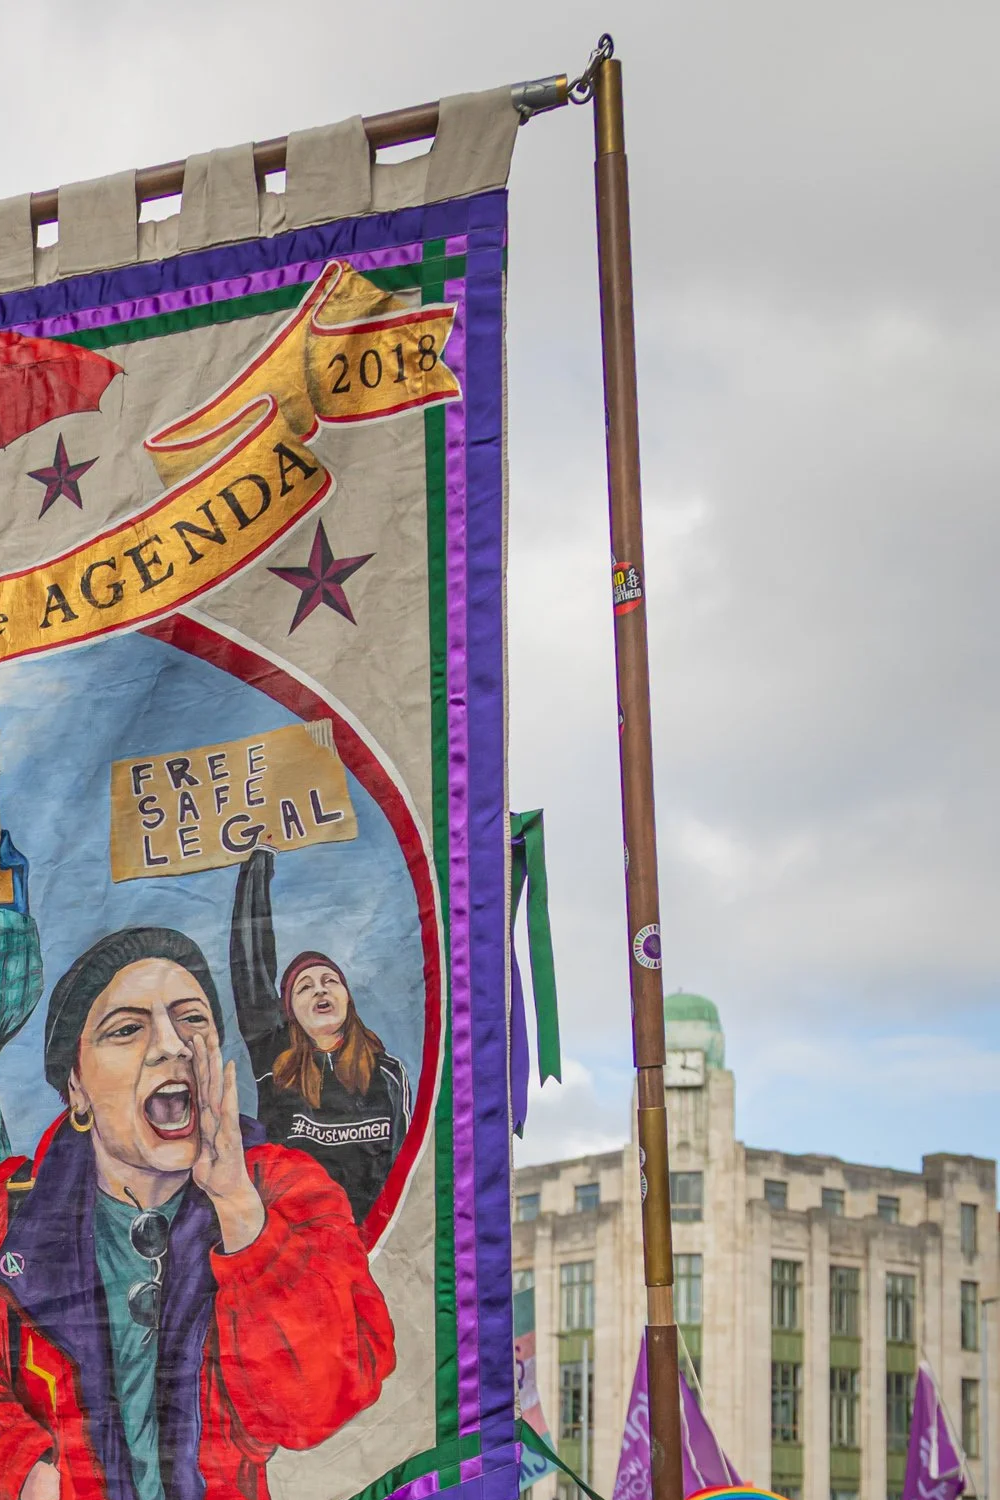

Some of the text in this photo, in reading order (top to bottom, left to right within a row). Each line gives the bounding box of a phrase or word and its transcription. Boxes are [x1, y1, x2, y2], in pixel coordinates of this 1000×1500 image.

[327, 334, 438, 395] 2018
[38, 440, 319, 629] AGENDA
[130, 744, 268, 796] FREE
[137, 776, 266, 830] SAFE
[143, 789, 345, 869] LEGAL
[291, 1120, 390, 1142] #trustwomen
